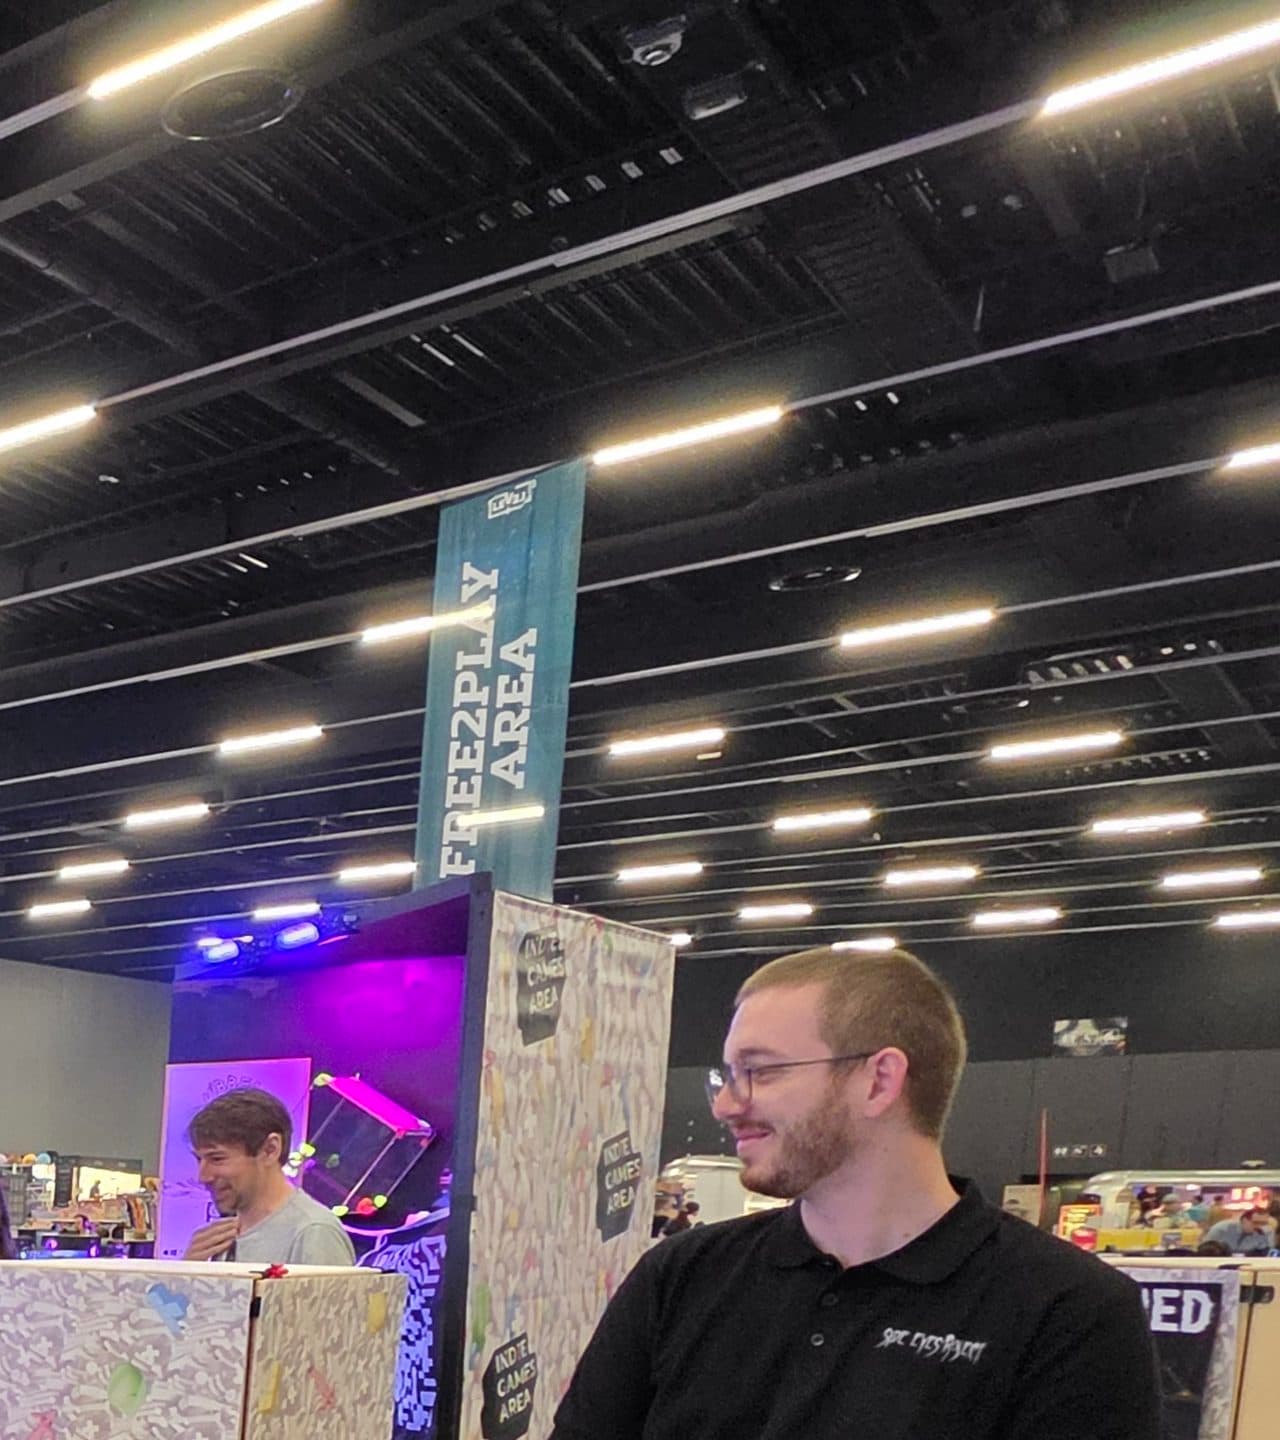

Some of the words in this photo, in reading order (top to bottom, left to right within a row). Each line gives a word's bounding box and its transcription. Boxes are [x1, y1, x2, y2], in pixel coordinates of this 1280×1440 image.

[441, 562, 499, 878] FREE2PLAY
[491, 628, 537, 789] AREA
[605, 1158, 642, 1191] GAMES
[606, 1185, 635, 1216] AREA
[495, 1339, 528, 1374] INDIE
[497, 1358, 536, 1397] GAMES
[499, 1388, 530, 1423] AREA
